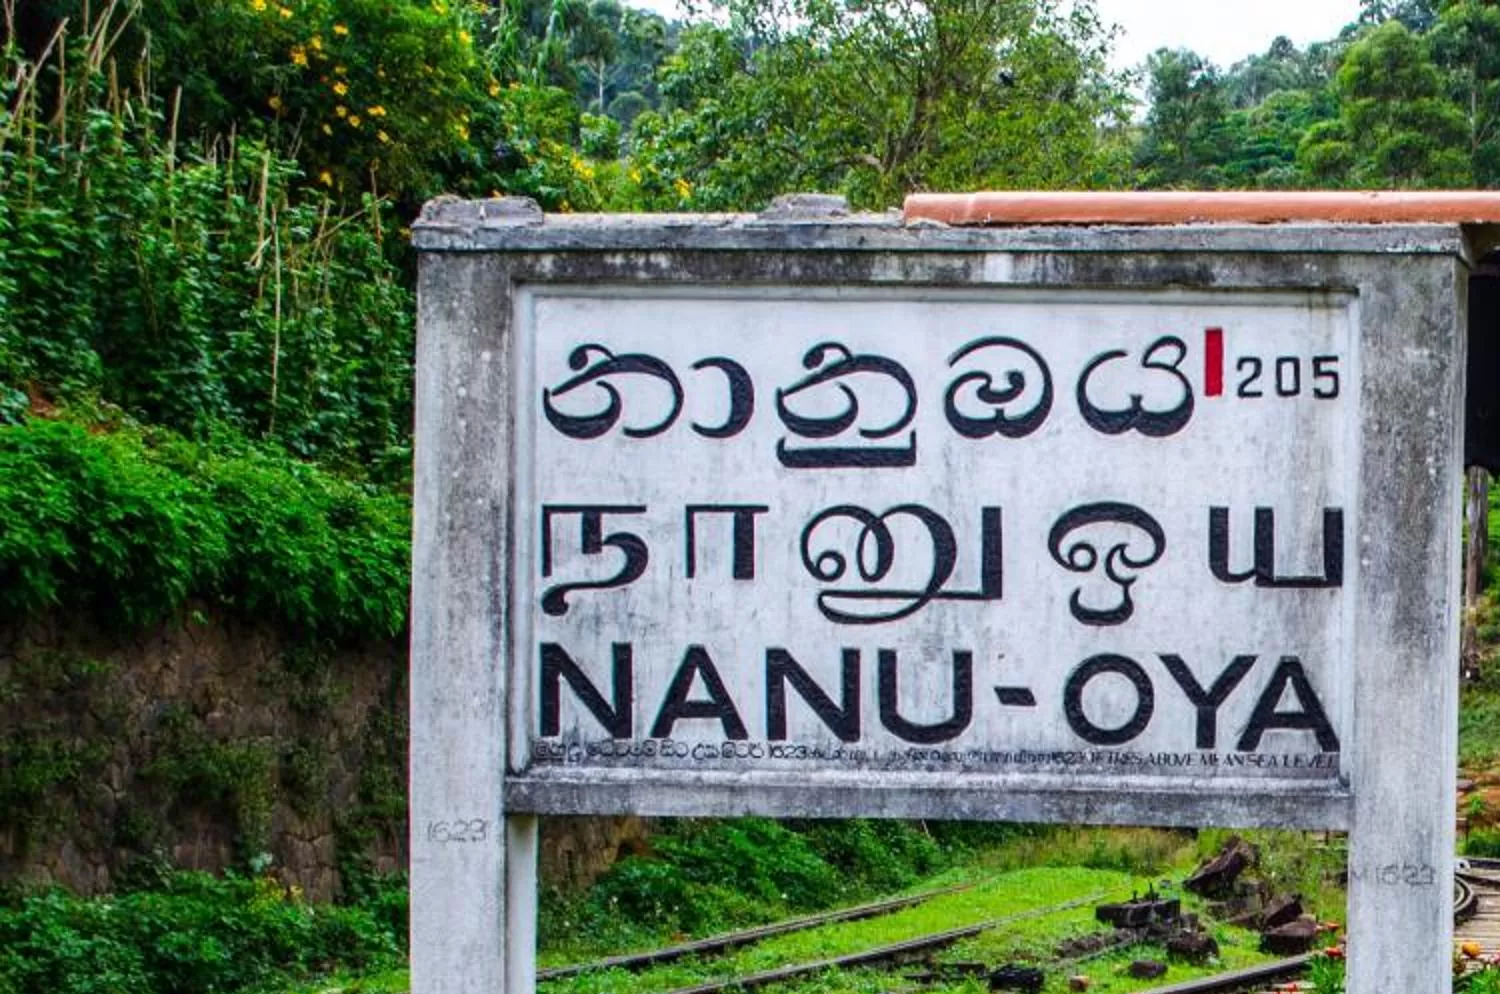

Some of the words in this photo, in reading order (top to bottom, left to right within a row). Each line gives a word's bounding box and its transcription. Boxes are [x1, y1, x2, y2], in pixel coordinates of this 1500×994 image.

[1236, 354, 1341, 400] 205
[538, 641, 1342, 752] NANU-OYA
[1148, 752, 1194, 767] ABOVE
[428, 818, 487, 843] 1623
